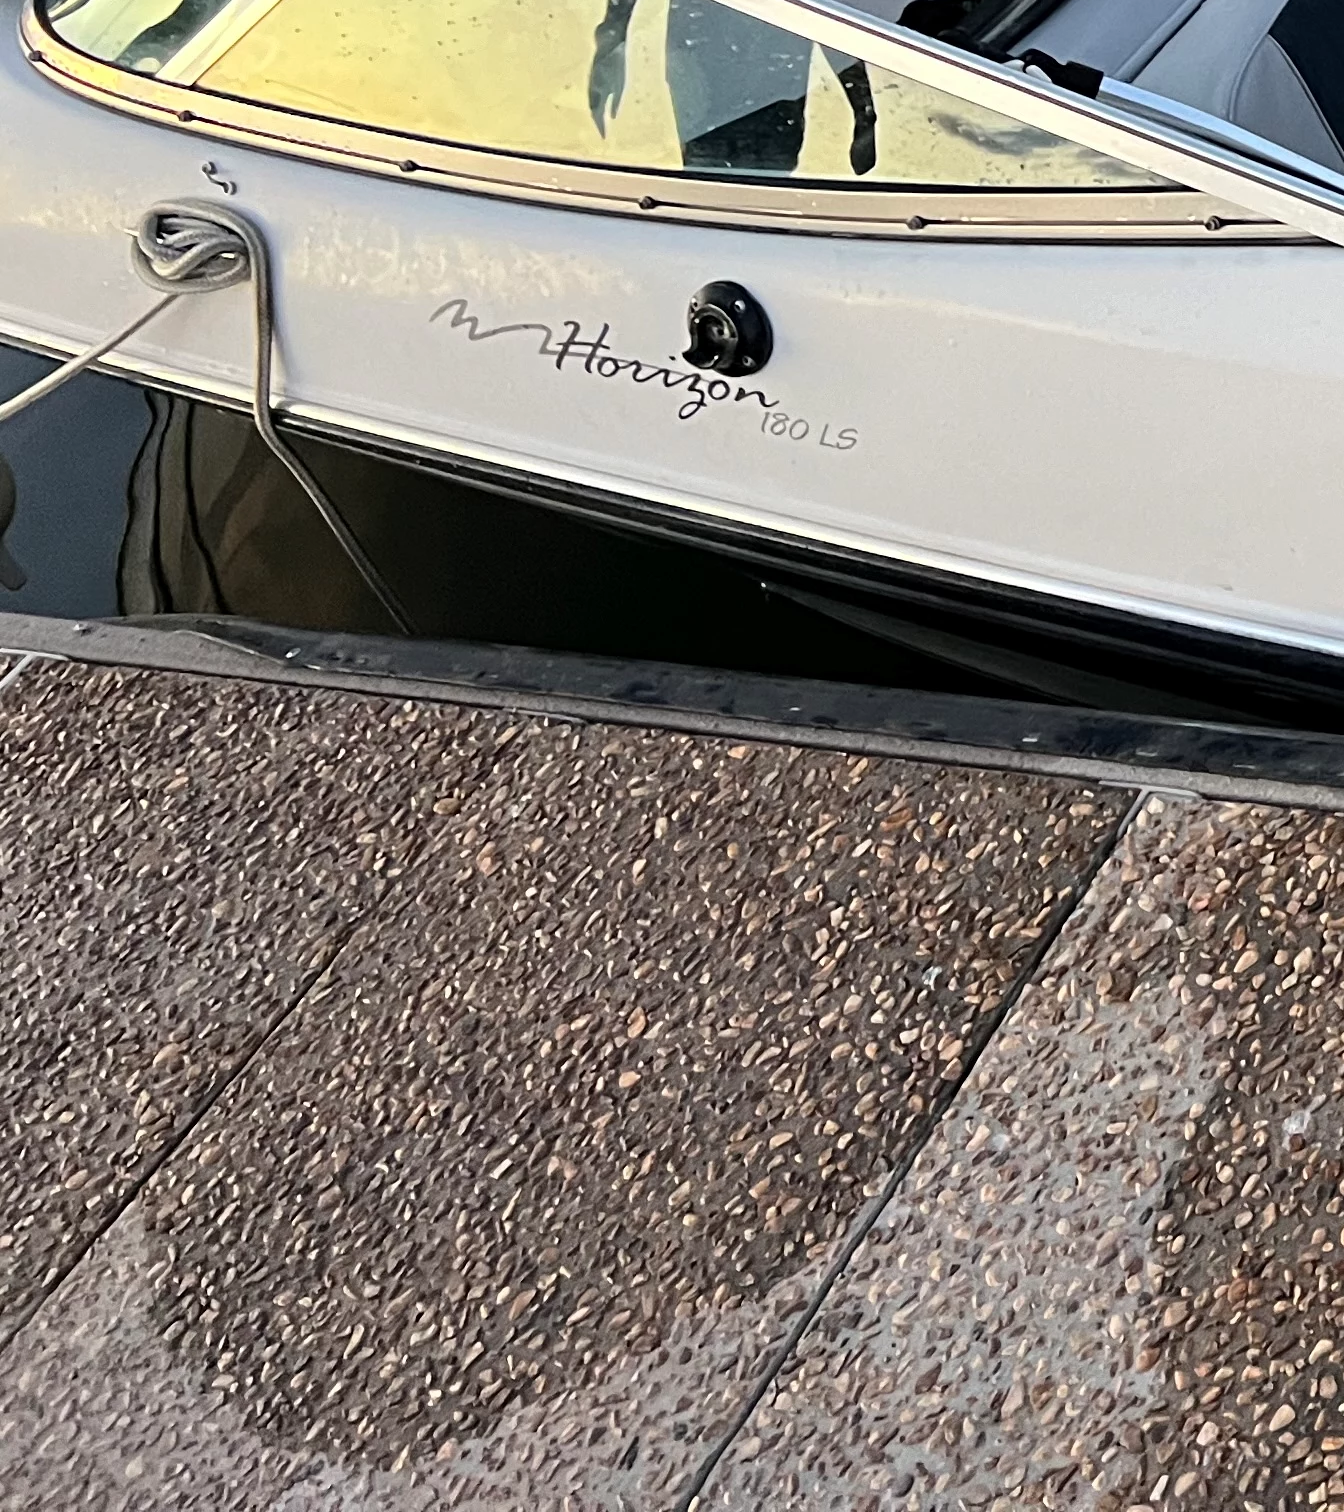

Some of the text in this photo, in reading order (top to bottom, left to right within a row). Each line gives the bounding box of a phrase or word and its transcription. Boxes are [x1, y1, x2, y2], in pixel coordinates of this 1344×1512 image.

[553, 320, 780, 420] Horizon
[760, 410, 858, 451] 180 LS
